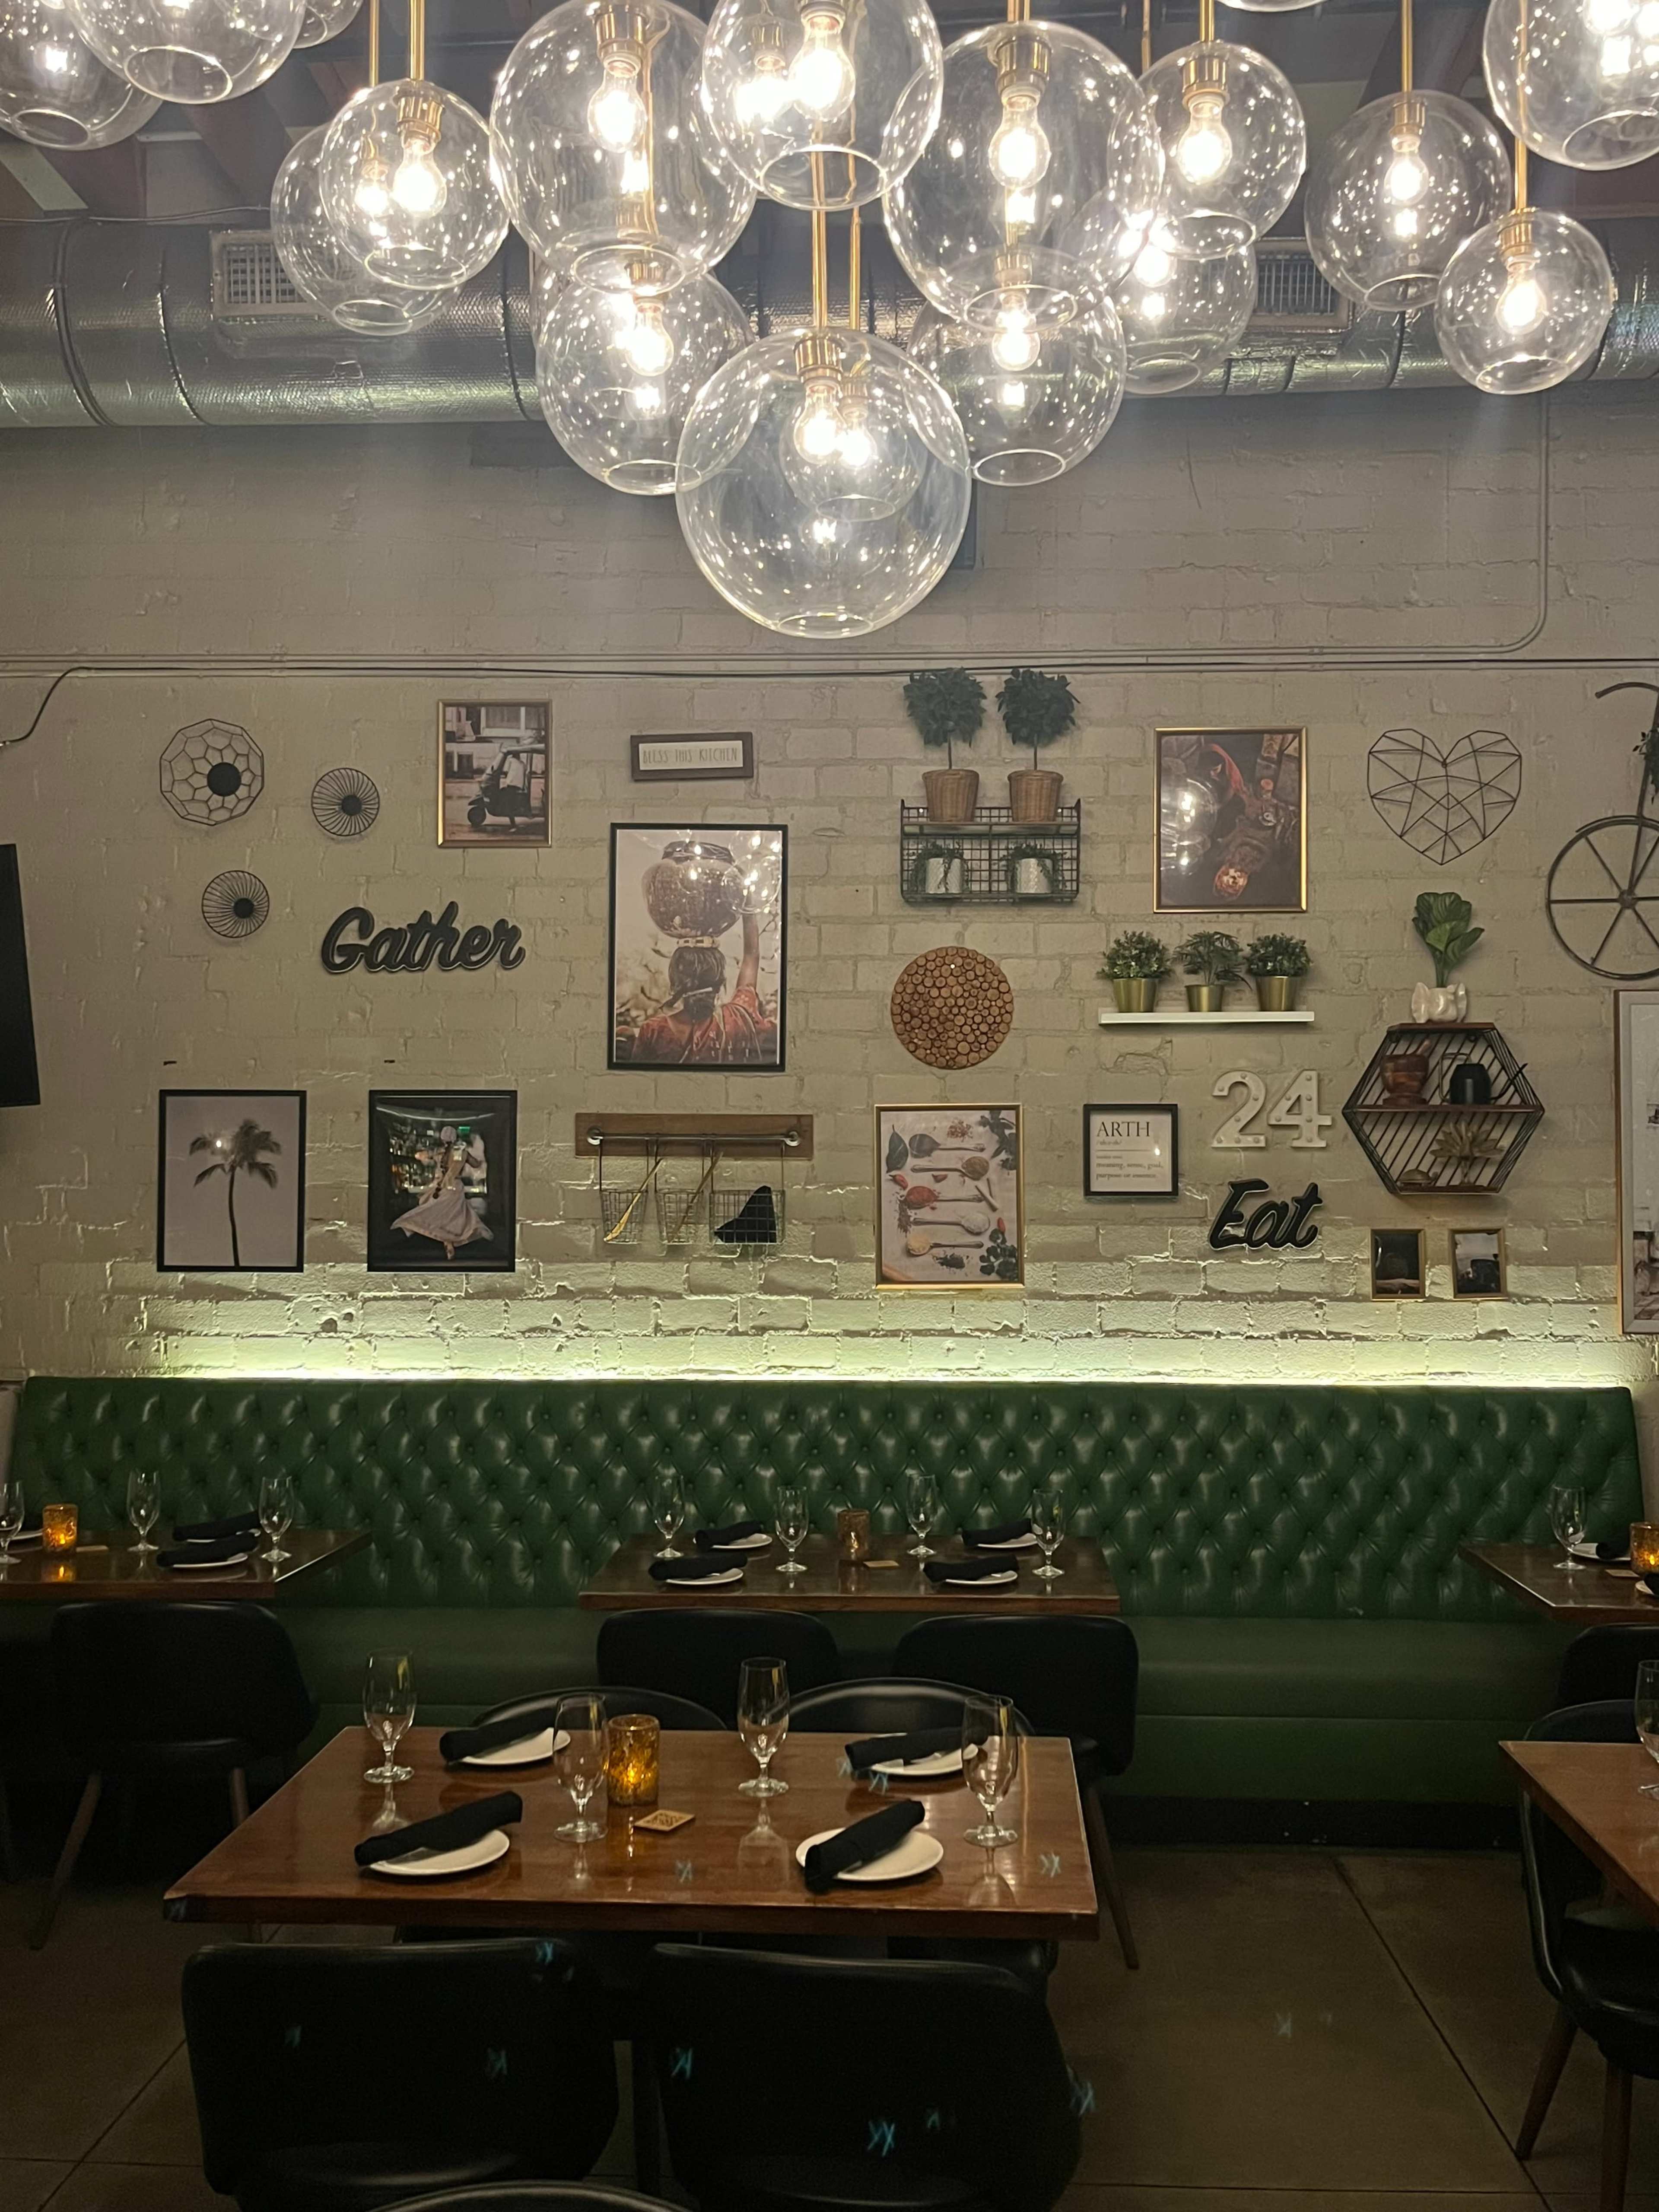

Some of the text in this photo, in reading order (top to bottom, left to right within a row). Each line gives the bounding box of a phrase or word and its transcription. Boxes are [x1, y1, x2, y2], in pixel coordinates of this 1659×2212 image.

[643, 747, 737, 764] BLESS THIS KITCHEN
[322, 901, 526, 973] Gather
[1096, 1121, 1150, 1137] ARTH
[1211, 1069, 1332, 1147] 24
[1208, 1179, 1323, 1250] Eat
